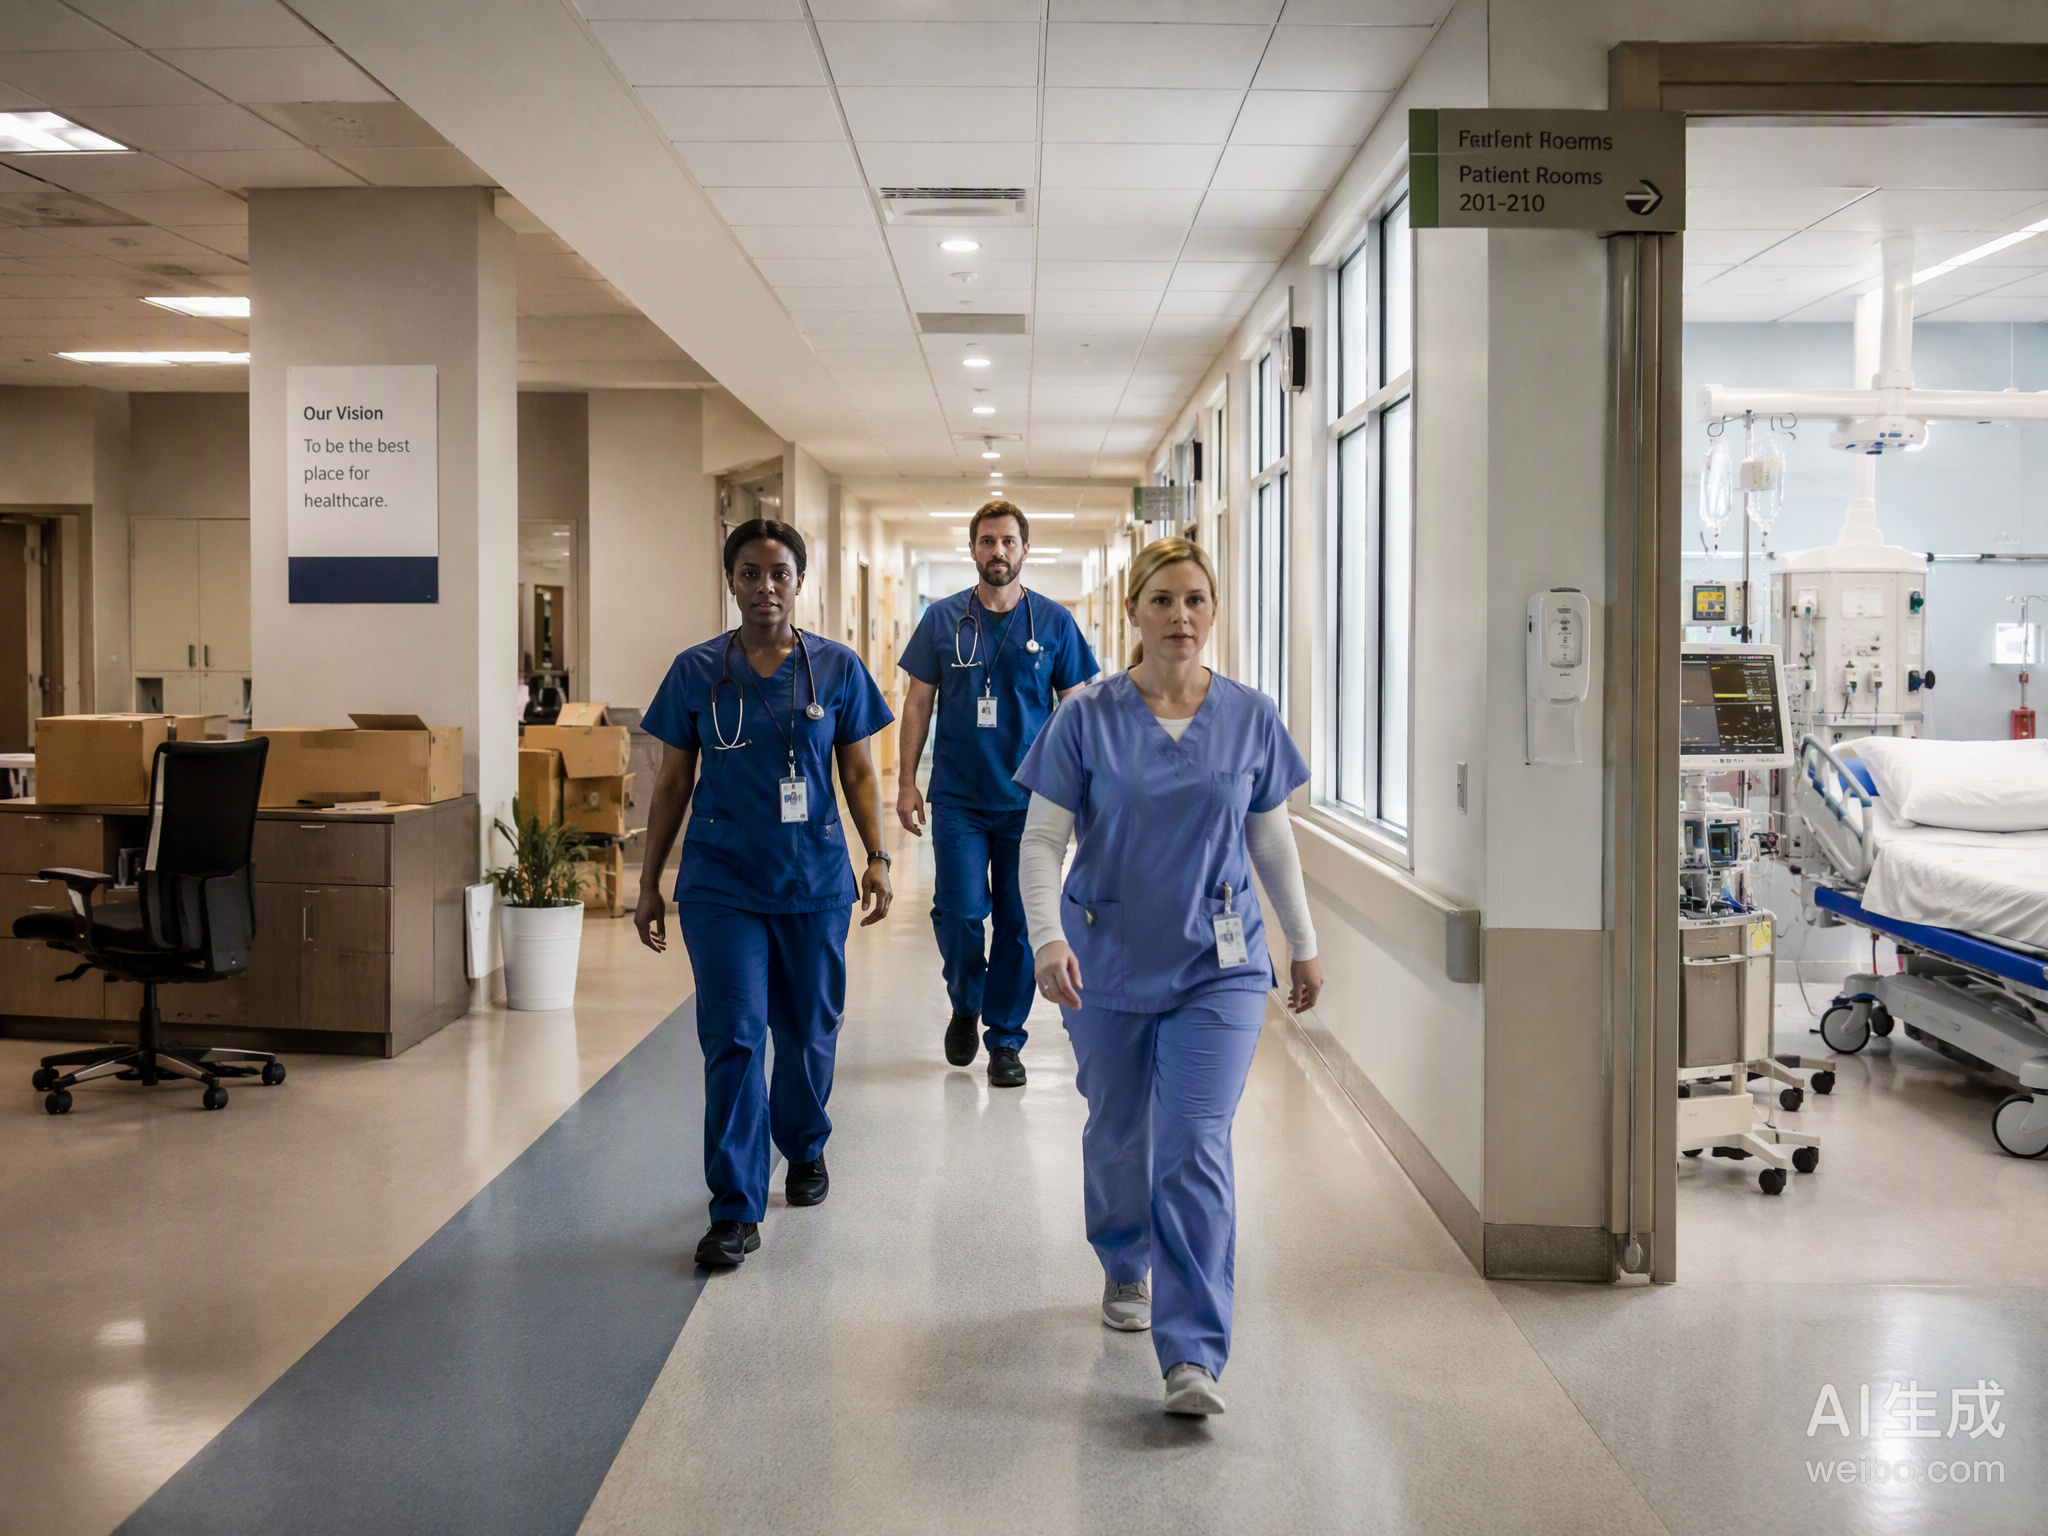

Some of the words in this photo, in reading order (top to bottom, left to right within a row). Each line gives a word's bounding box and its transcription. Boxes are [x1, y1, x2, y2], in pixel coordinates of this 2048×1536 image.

[1459, 165, 1530, 184] Patient
[1536, 166, 1603, 185] Rooms
[1459, 193, 1545, 212] 201-210
[303, 406, 332, 421] Our
[336, 405, 383, 420] Vision
[304, 439, 321, 453] To
[325, 438, 344, 453] be
[348, 438, 373, 453] the
[378, 438, 410, 453] best
[304, 465, 345, 484] place
[349, 465, 370, 480] for
[304, 493, 388, 508] healthcare.
